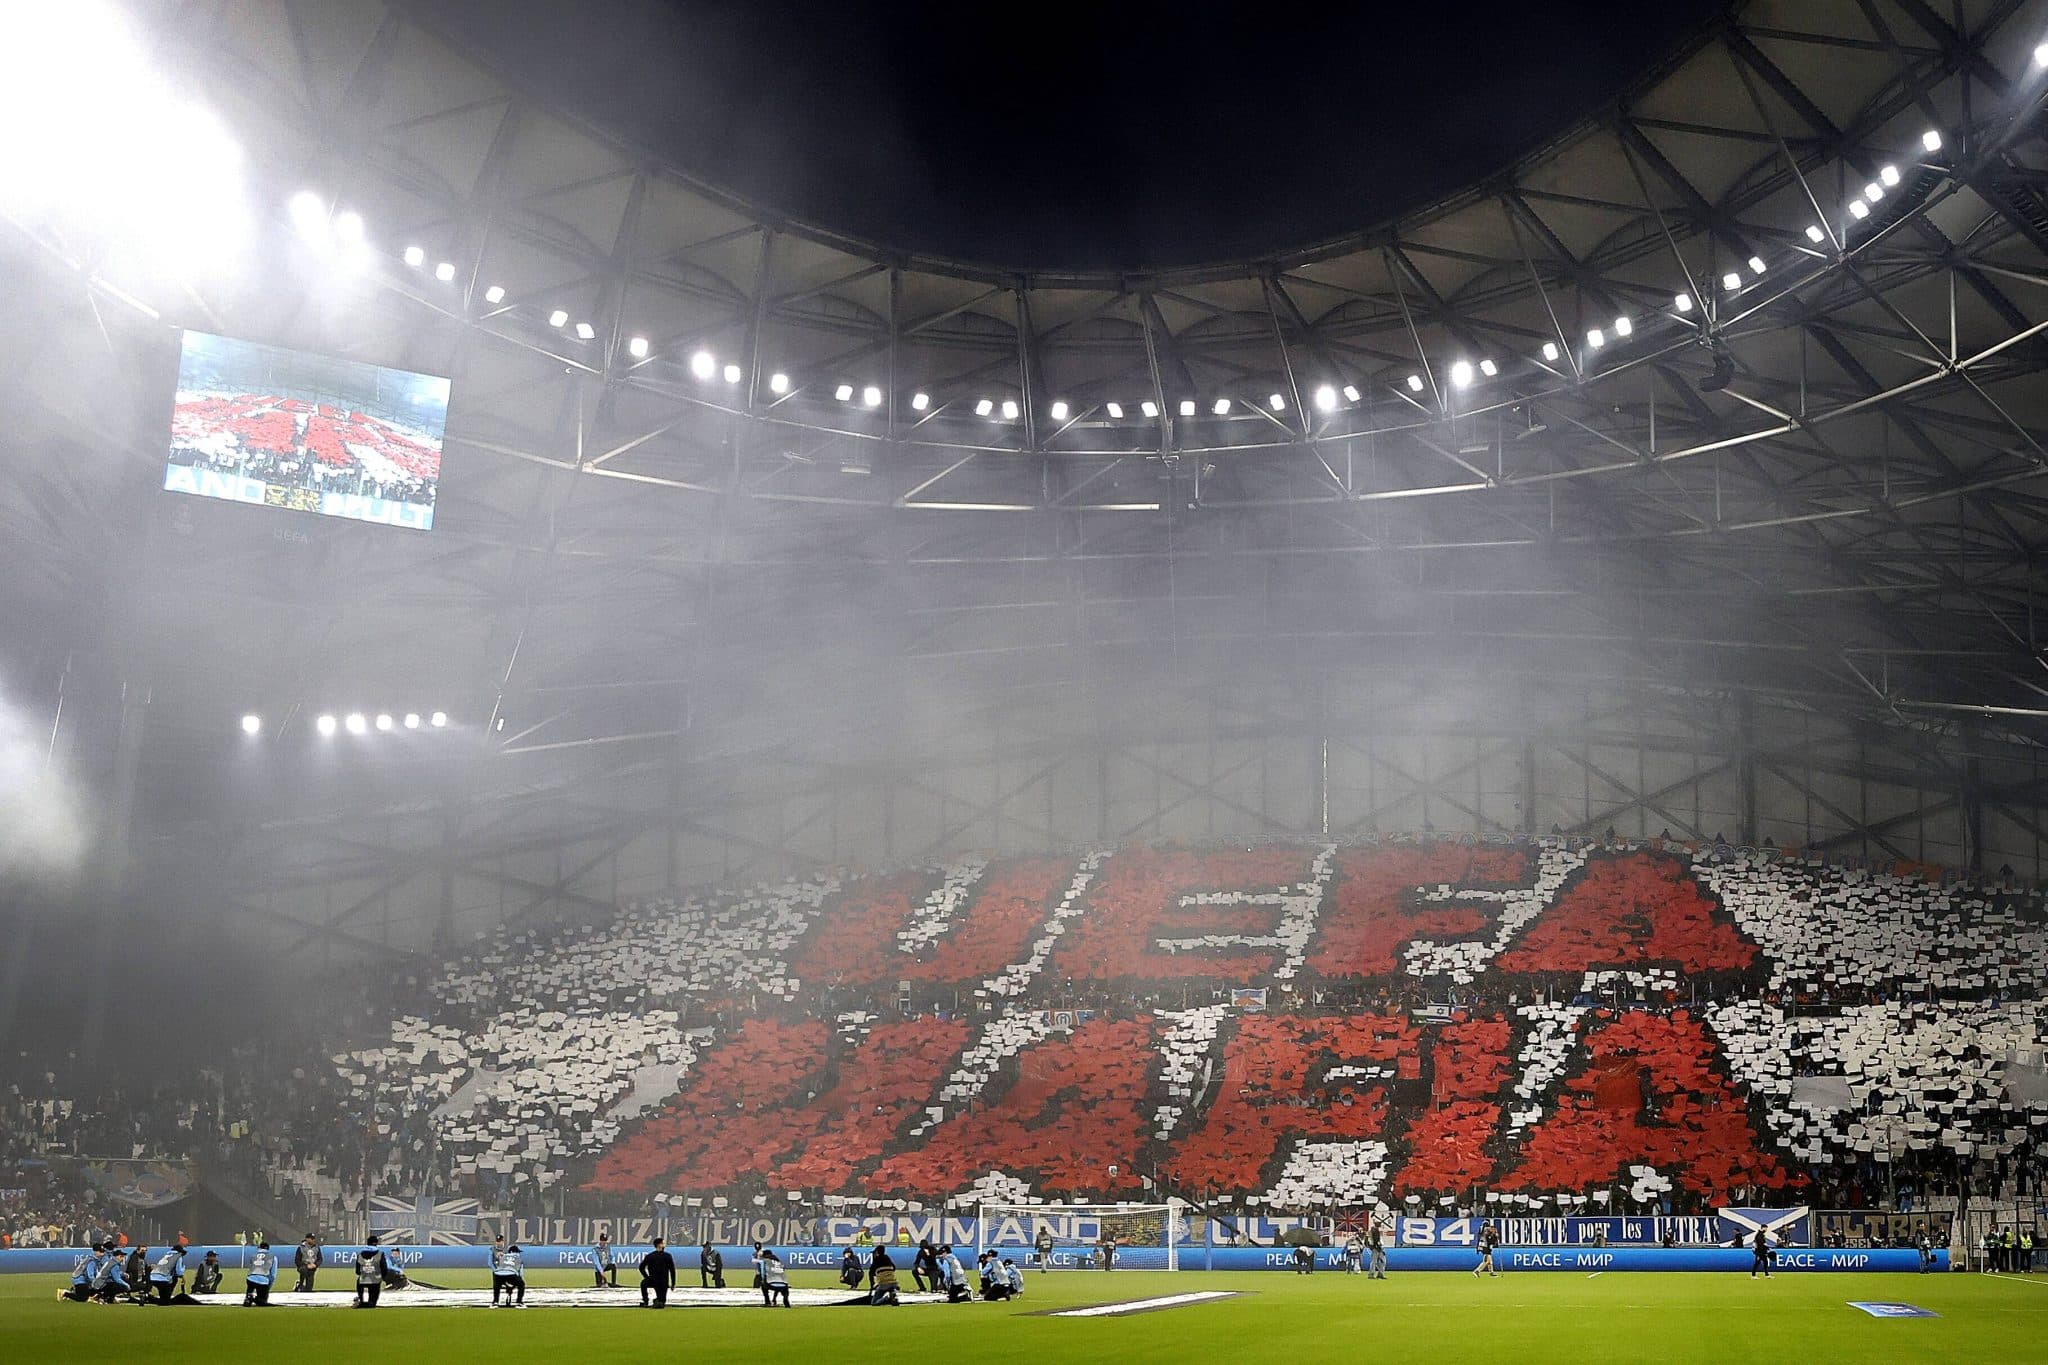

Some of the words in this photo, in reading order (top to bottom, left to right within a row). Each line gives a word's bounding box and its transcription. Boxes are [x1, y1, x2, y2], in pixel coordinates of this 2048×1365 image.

[797, 840, 1758, 986] UEFA
[1402, 1217, 1474, 1244] 84
[1622, 1217, 1641, 1239] les
[399, 1251, 422, 1263] ИР
[559, 1251, 594, 1263] PEAC
[789, 1252, 833, 1264] PEACE
[1025, 1252, 1070, 1265] PACE
[1513, 1253, 1561, 1266] PEACE
[1577, 1253, 1613, 1266] МИР
[1767, 1254, 1815, 1267] EACE
[1831, 1254, 1869, 1267] МИР
